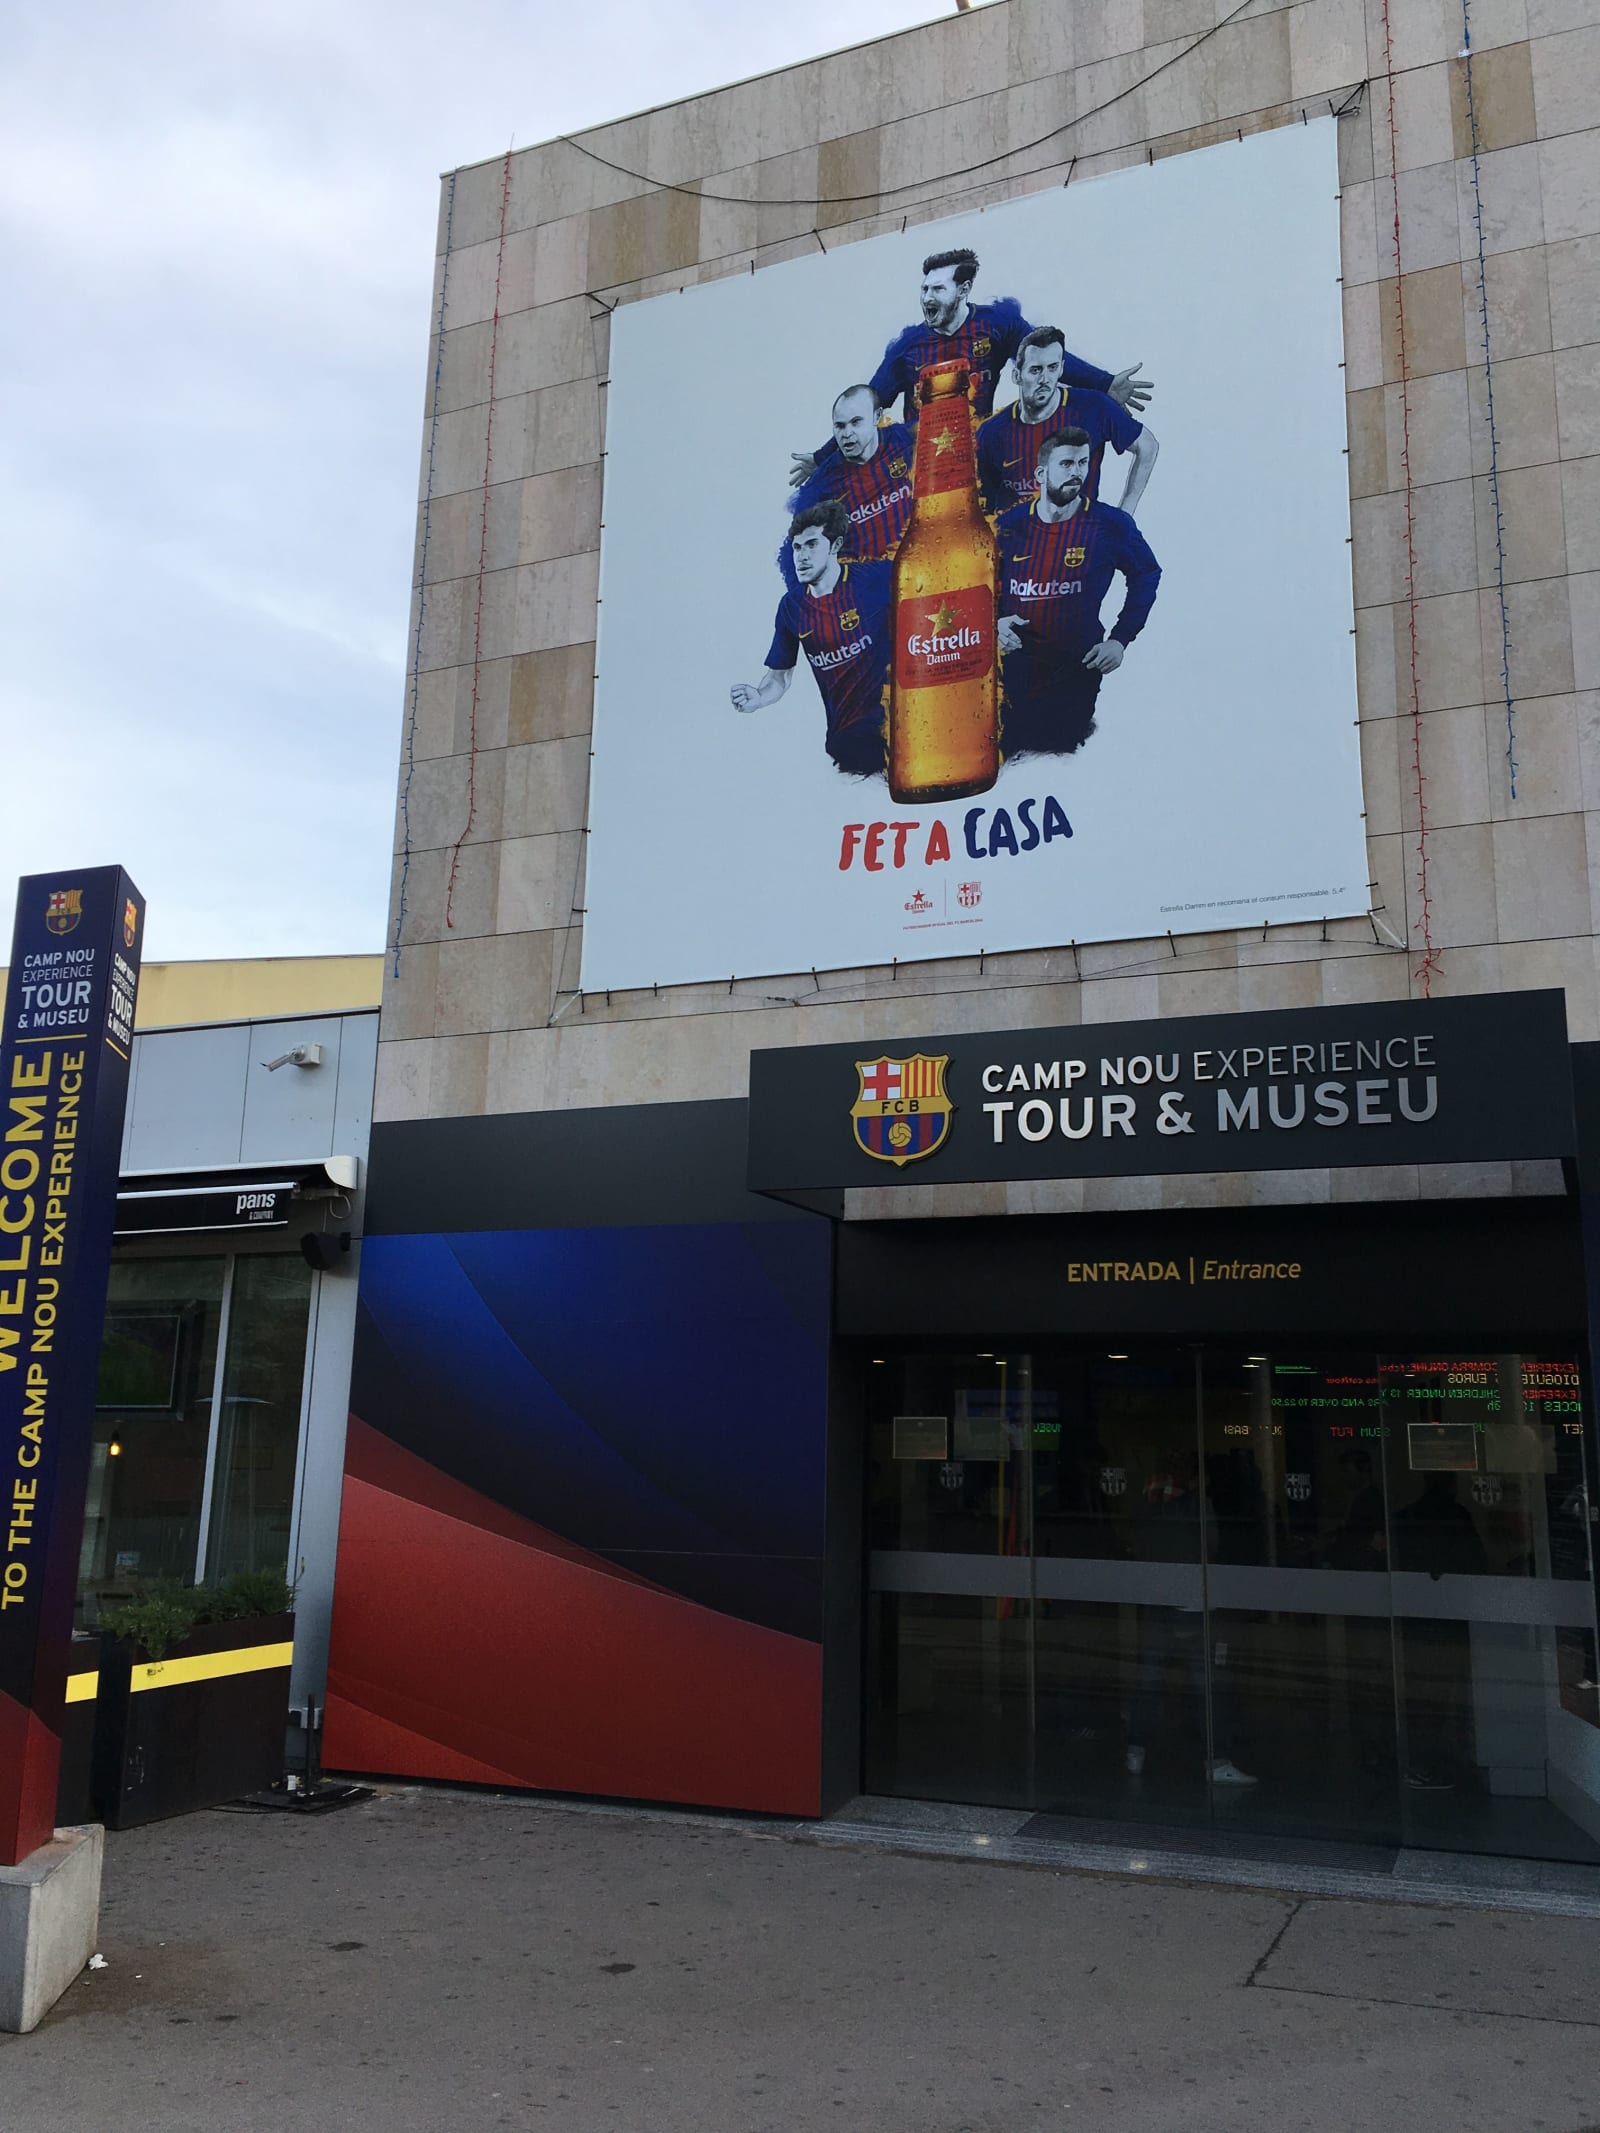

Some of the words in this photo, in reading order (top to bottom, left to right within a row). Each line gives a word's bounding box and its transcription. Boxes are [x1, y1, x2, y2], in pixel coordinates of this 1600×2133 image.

[1003, 478, 1041, 491] Raku
[1010, 578, 1082, 596] Rakuten
[908, 627, 981, 656] Estrella
[926, 652, 961, 666] Damm
[838, 821, 920, 872] FET
[925, 819, 951, 866] A
[963, 795, 1074, 859] CASA
[1185, 903, 1207, 911] Damm
[1259, 894, 1286, 903] consum
[24, 952, 62, 967] CAMP
[65, 948, 95, 964] NOU
[22, 964, 94, 983] EXPERIENCE
[21, 980, 92, 1010] TOUR
[111, 983, 133, 1027] TOUR
[17, 1013, 28, 1029] &
[33, 1007, 90, 1027] MUSEU
[982, 1060, 1087, 1093] CAMP
[1101, 1053, 1180, 1086] NOU
[1193, 1035, 1437, 1081] EXPERIENCE
[982, 1094, 1137, 1143] TOUR
[1156, 1091, 1196, 1135] &
[1217, 1076, 1438, 1132] MUSEU
[40, 1050, 85, 1266] EXPERIENCE
[0, 1050, 52, 1372] WELCOME
[236, 1193, 276, 1215] pans
[1067, 1261, 1182, 1283] ENTRADA
[1203, 1260, 1301, 1280] Entrance
[30, 1277, 60, 1352] NOU
[17, 1362, 49, 1468] CAMP
[7, 1478, 37, 1552] THE
[1, 1562, 28, 1610] TO
